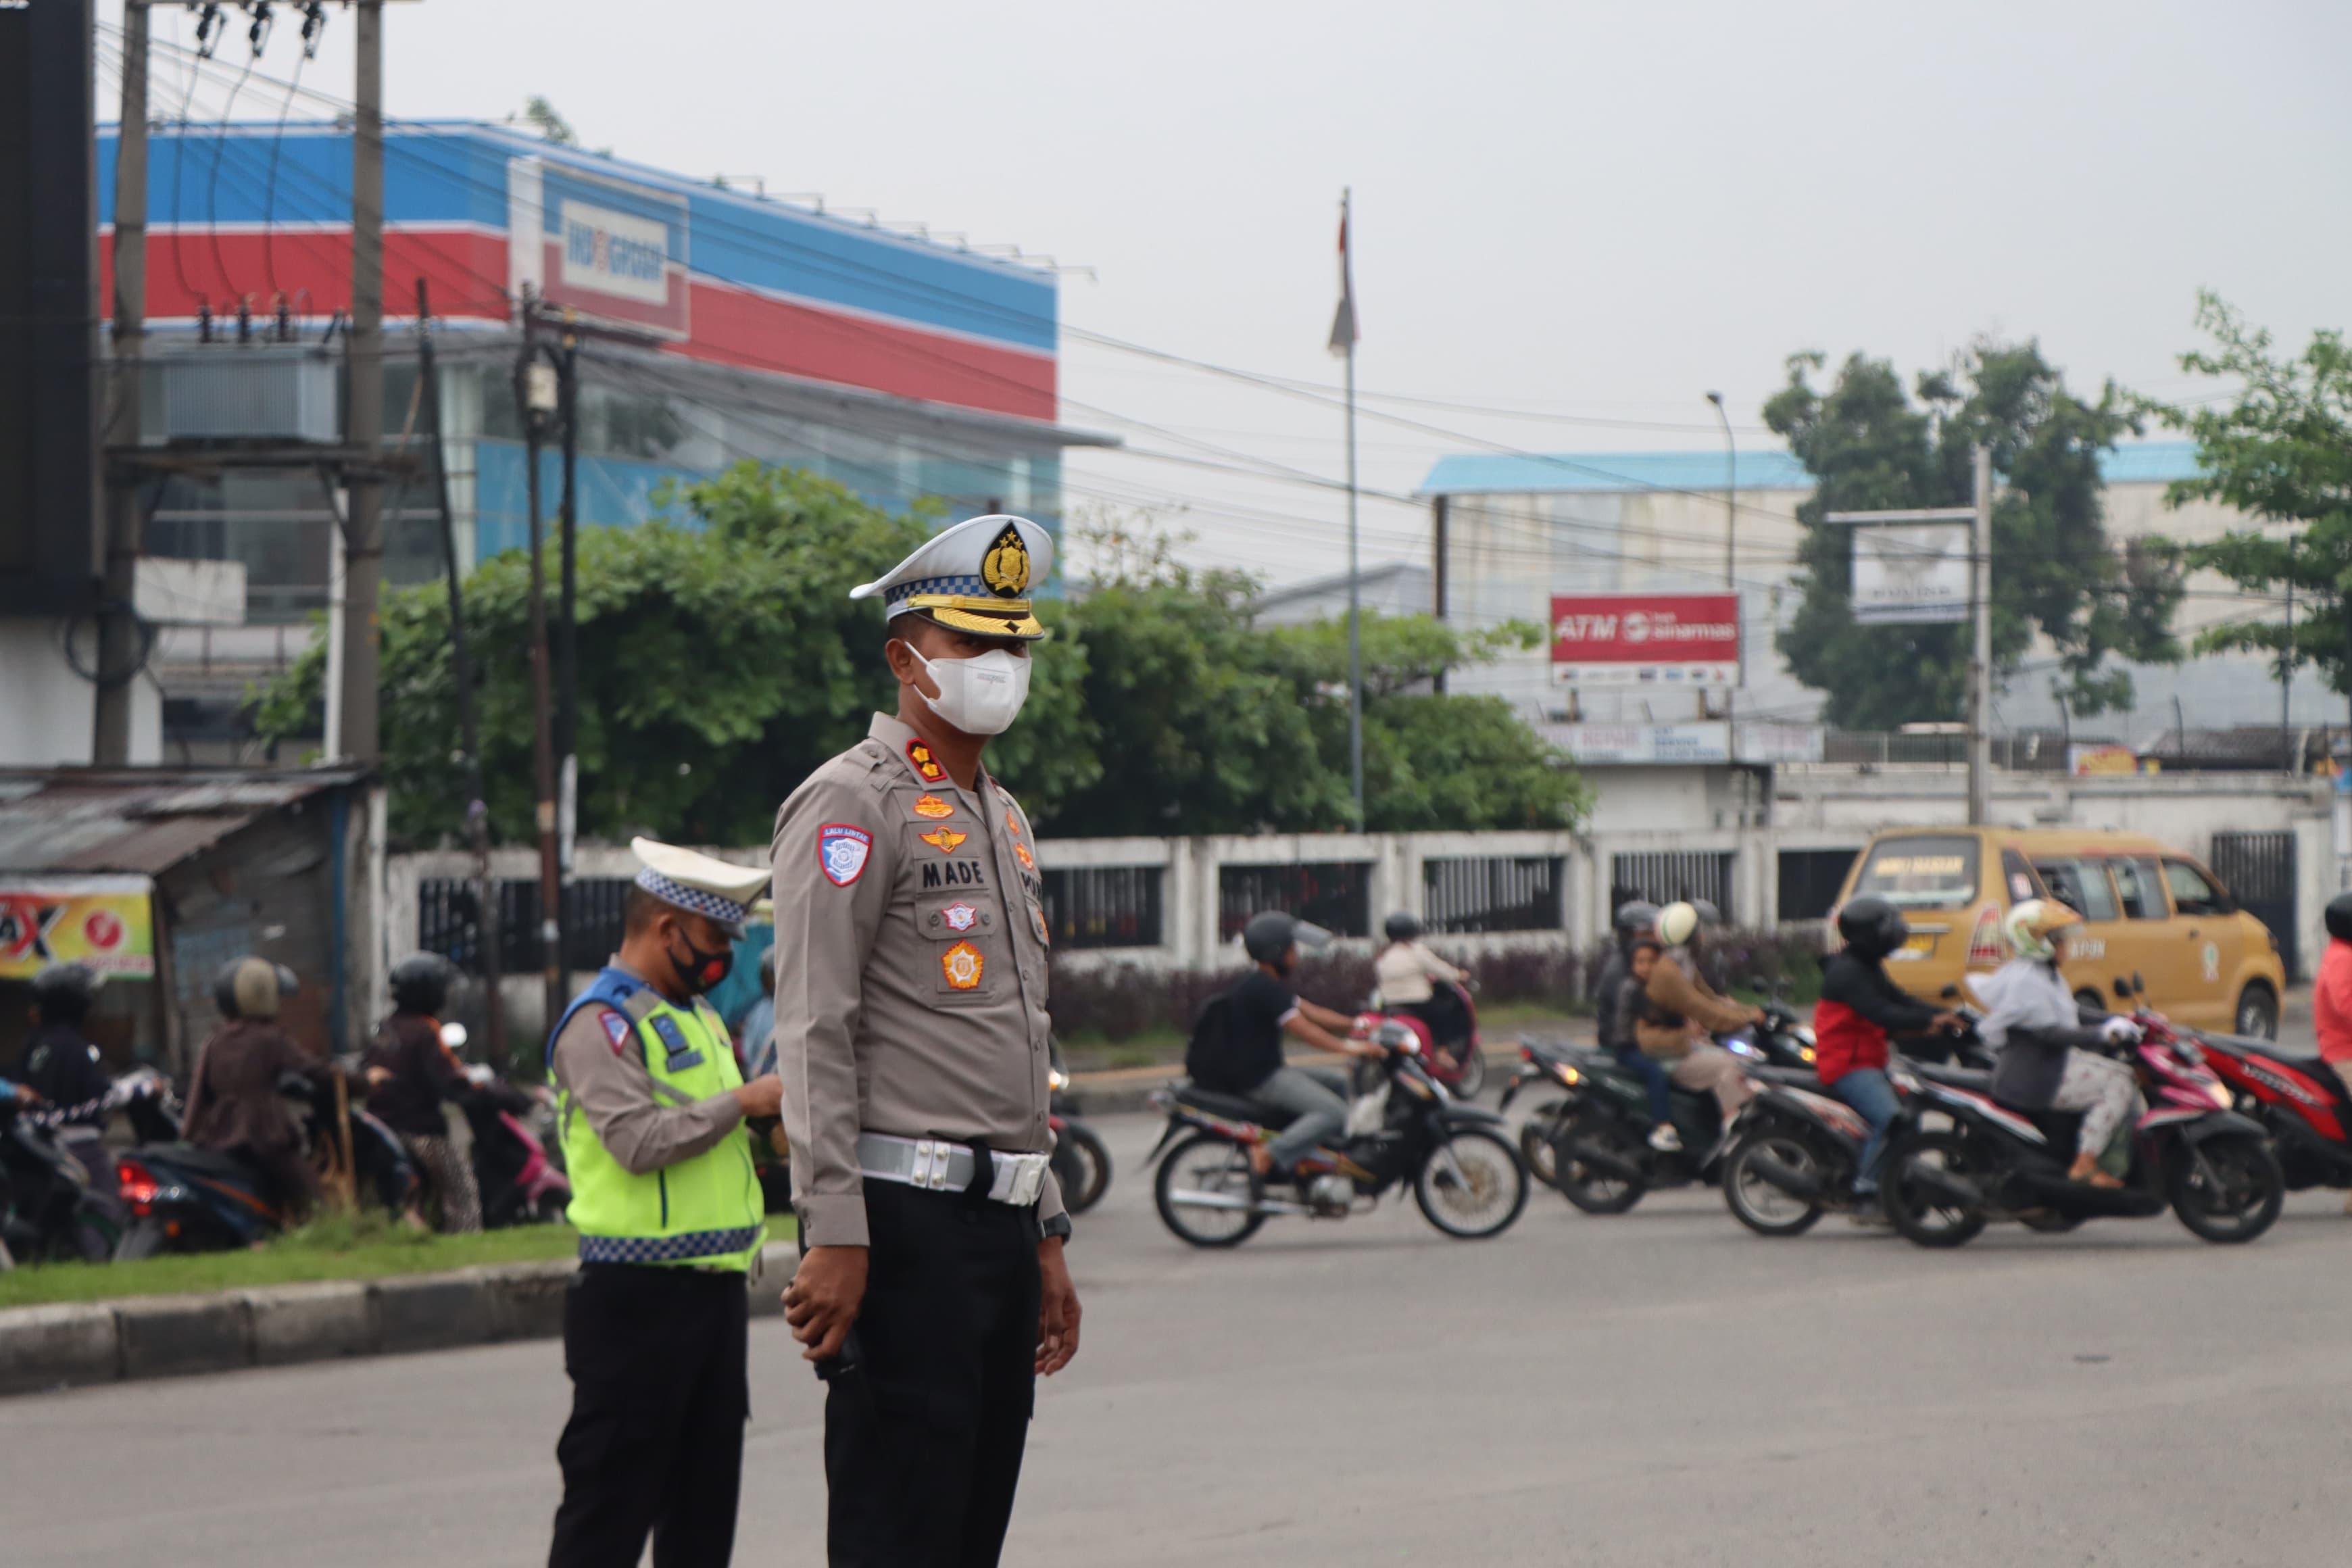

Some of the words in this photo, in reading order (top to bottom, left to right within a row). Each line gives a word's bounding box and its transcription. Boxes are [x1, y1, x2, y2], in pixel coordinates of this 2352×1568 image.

[1557, 613, 1618, 640] ATM
[1654, 622, 1736, 641] sinarmas
[824, 827, 844, 835] LALU
[923, 861, 983, 888] MADE
